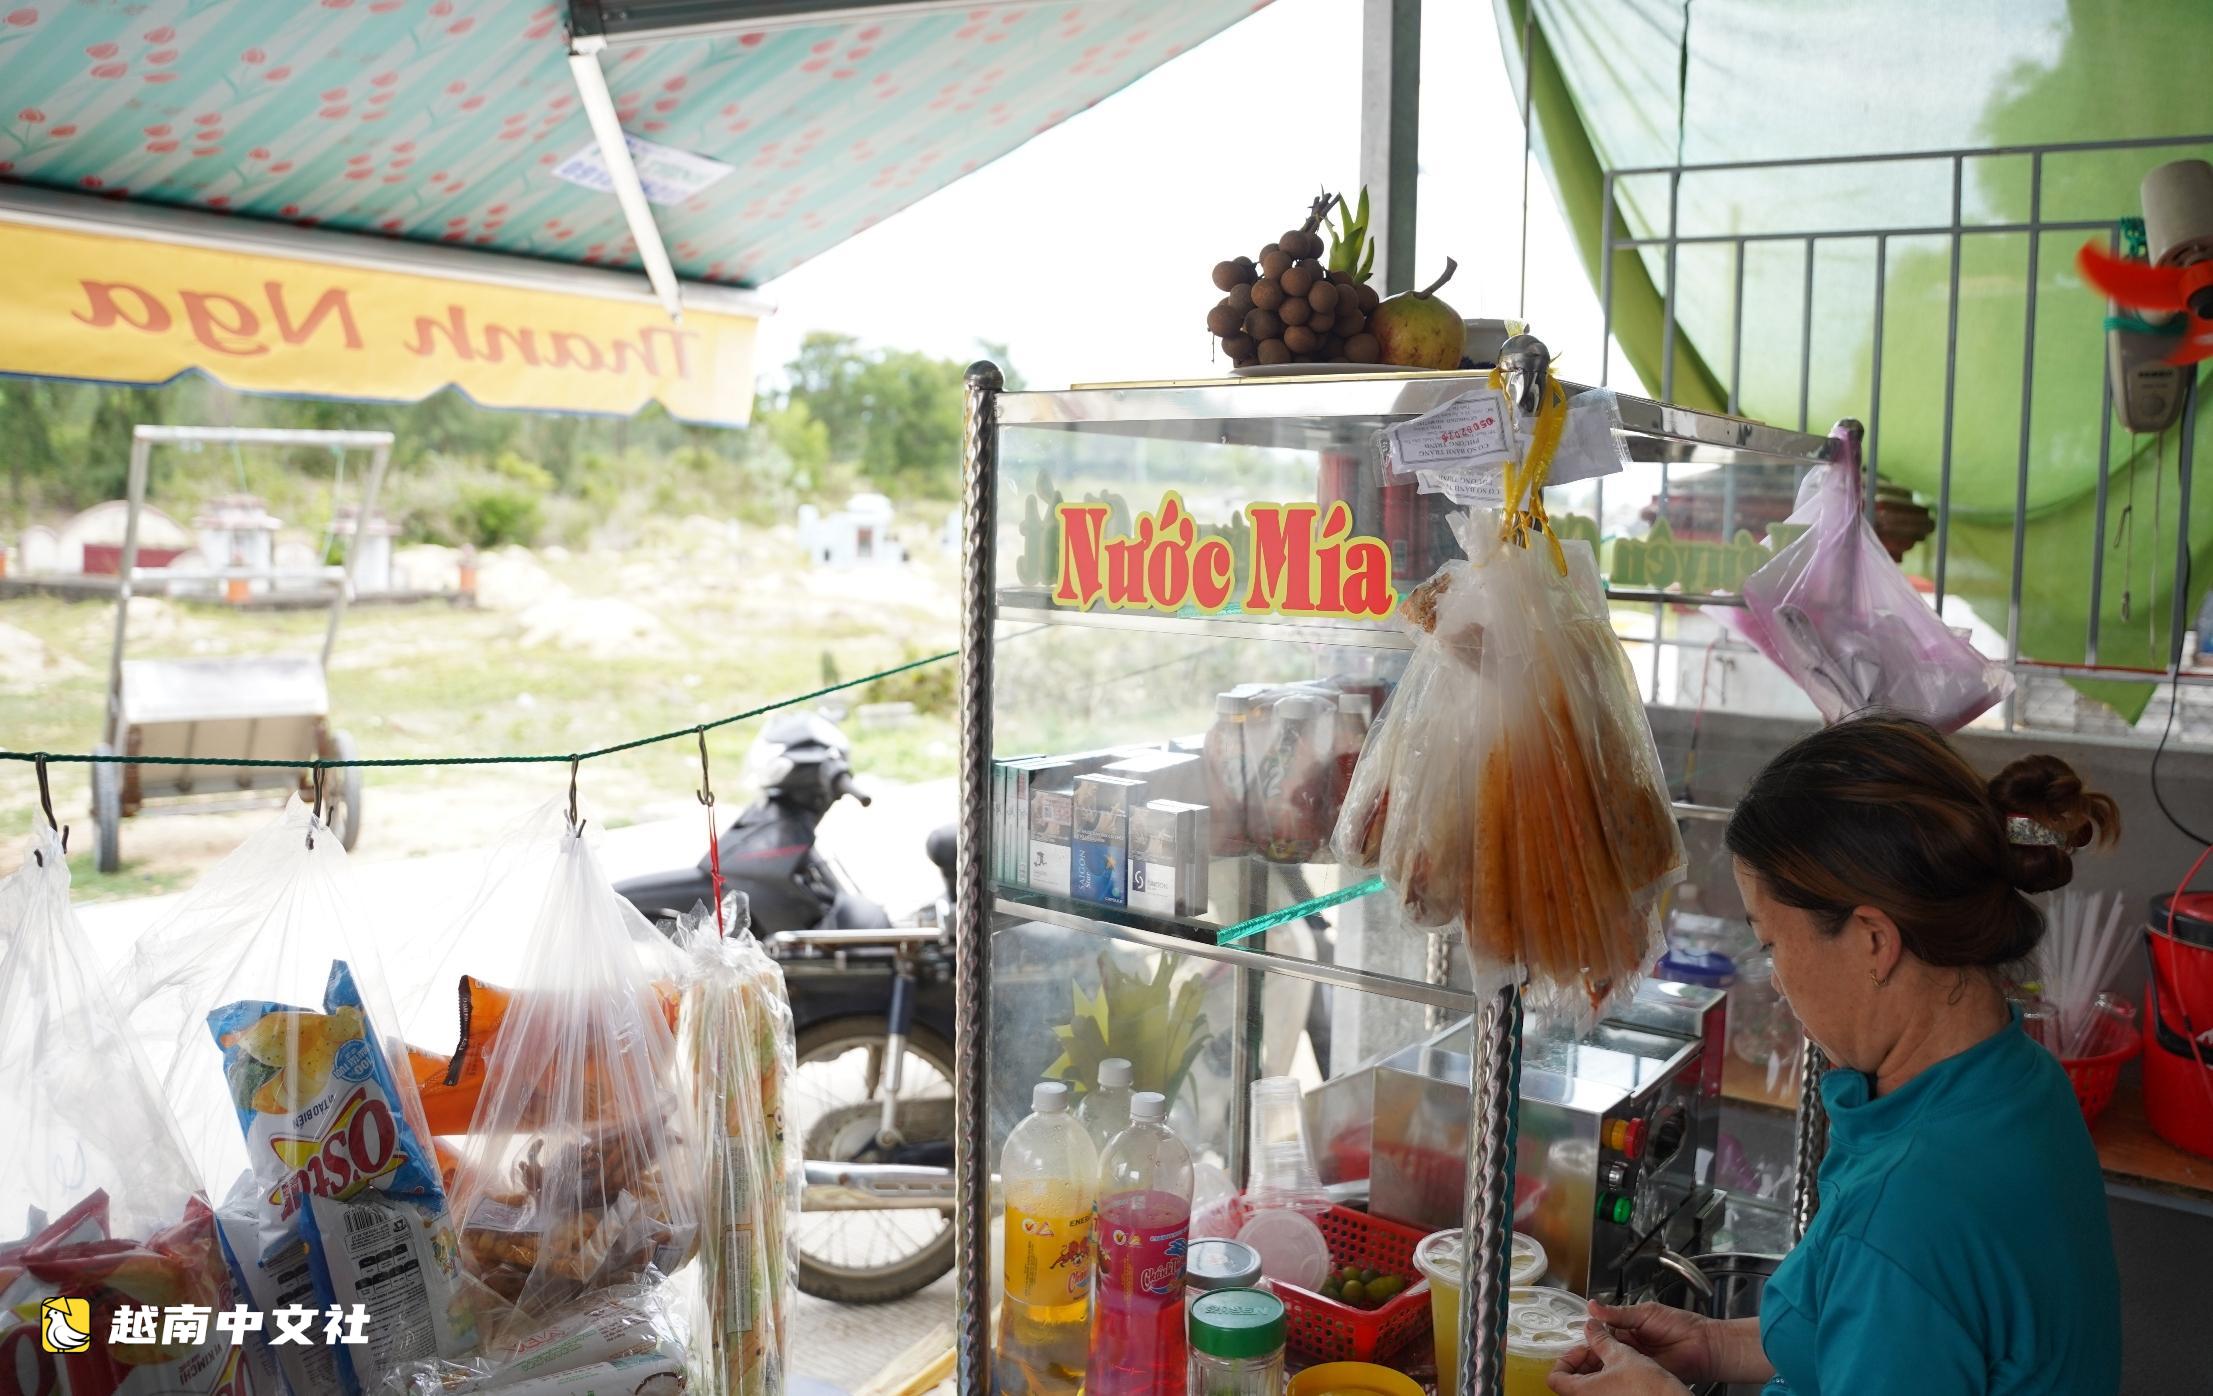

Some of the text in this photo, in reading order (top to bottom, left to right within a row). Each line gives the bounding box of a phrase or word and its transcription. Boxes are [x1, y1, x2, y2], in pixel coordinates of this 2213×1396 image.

[1055, 496, 1233, 609] Nước
[1246, 504, 1394, 617] Mía
[179, 1350, 215, 1387] KIMCHI
